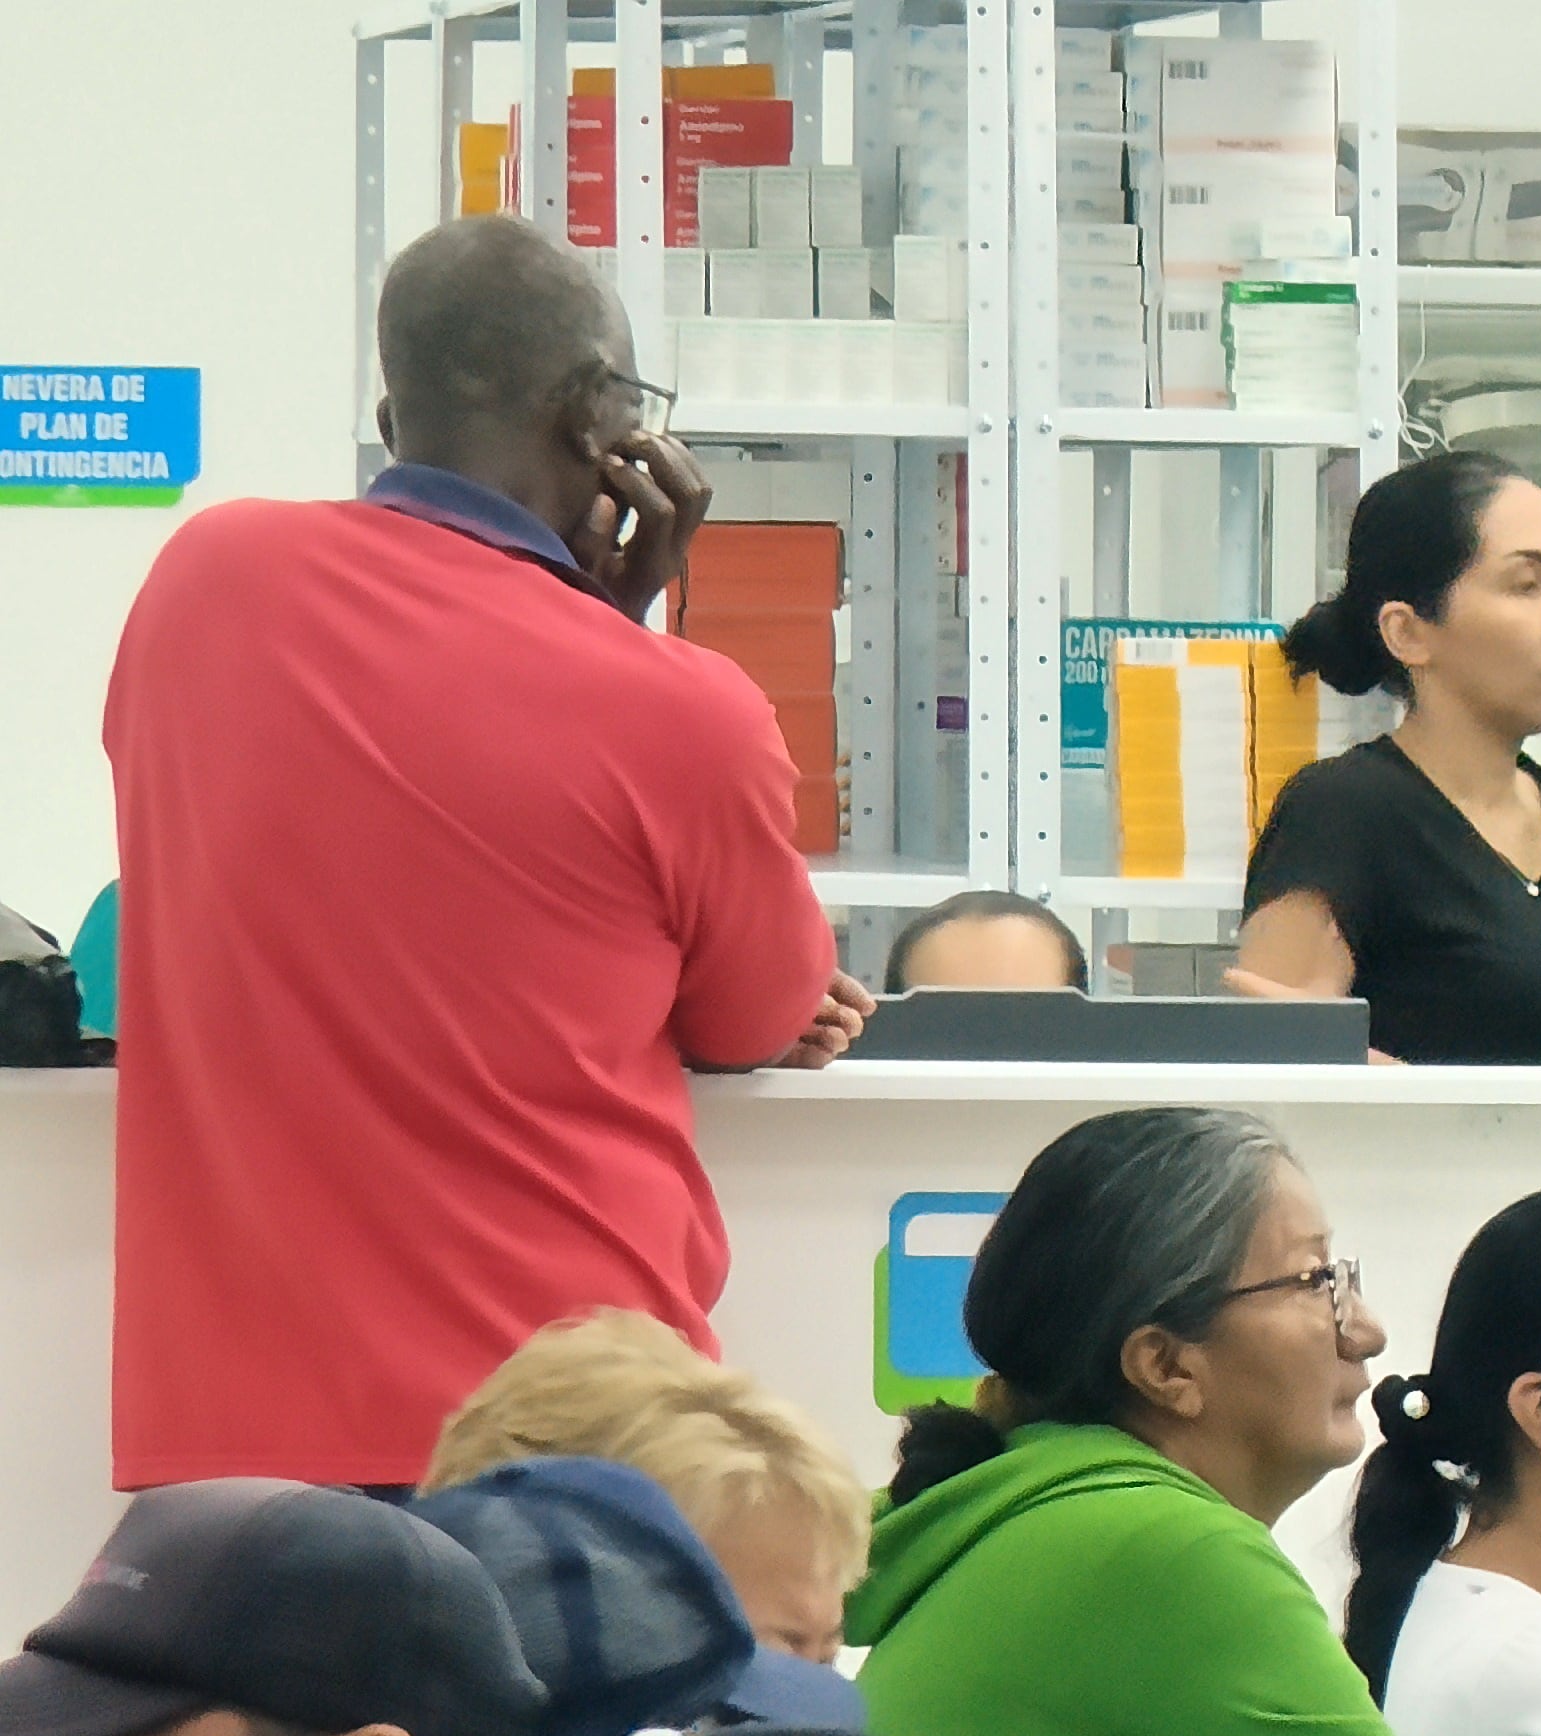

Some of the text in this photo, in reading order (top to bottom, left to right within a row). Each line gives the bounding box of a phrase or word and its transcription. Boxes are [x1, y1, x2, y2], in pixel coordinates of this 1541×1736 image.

[3, 374, 145, 402] NEVERA DE
[20, 411, 128, 440] PLAN DE
[0, 450, 169, 479] ONTINGENCIA
[1064, 661, 1097, 684] 200
